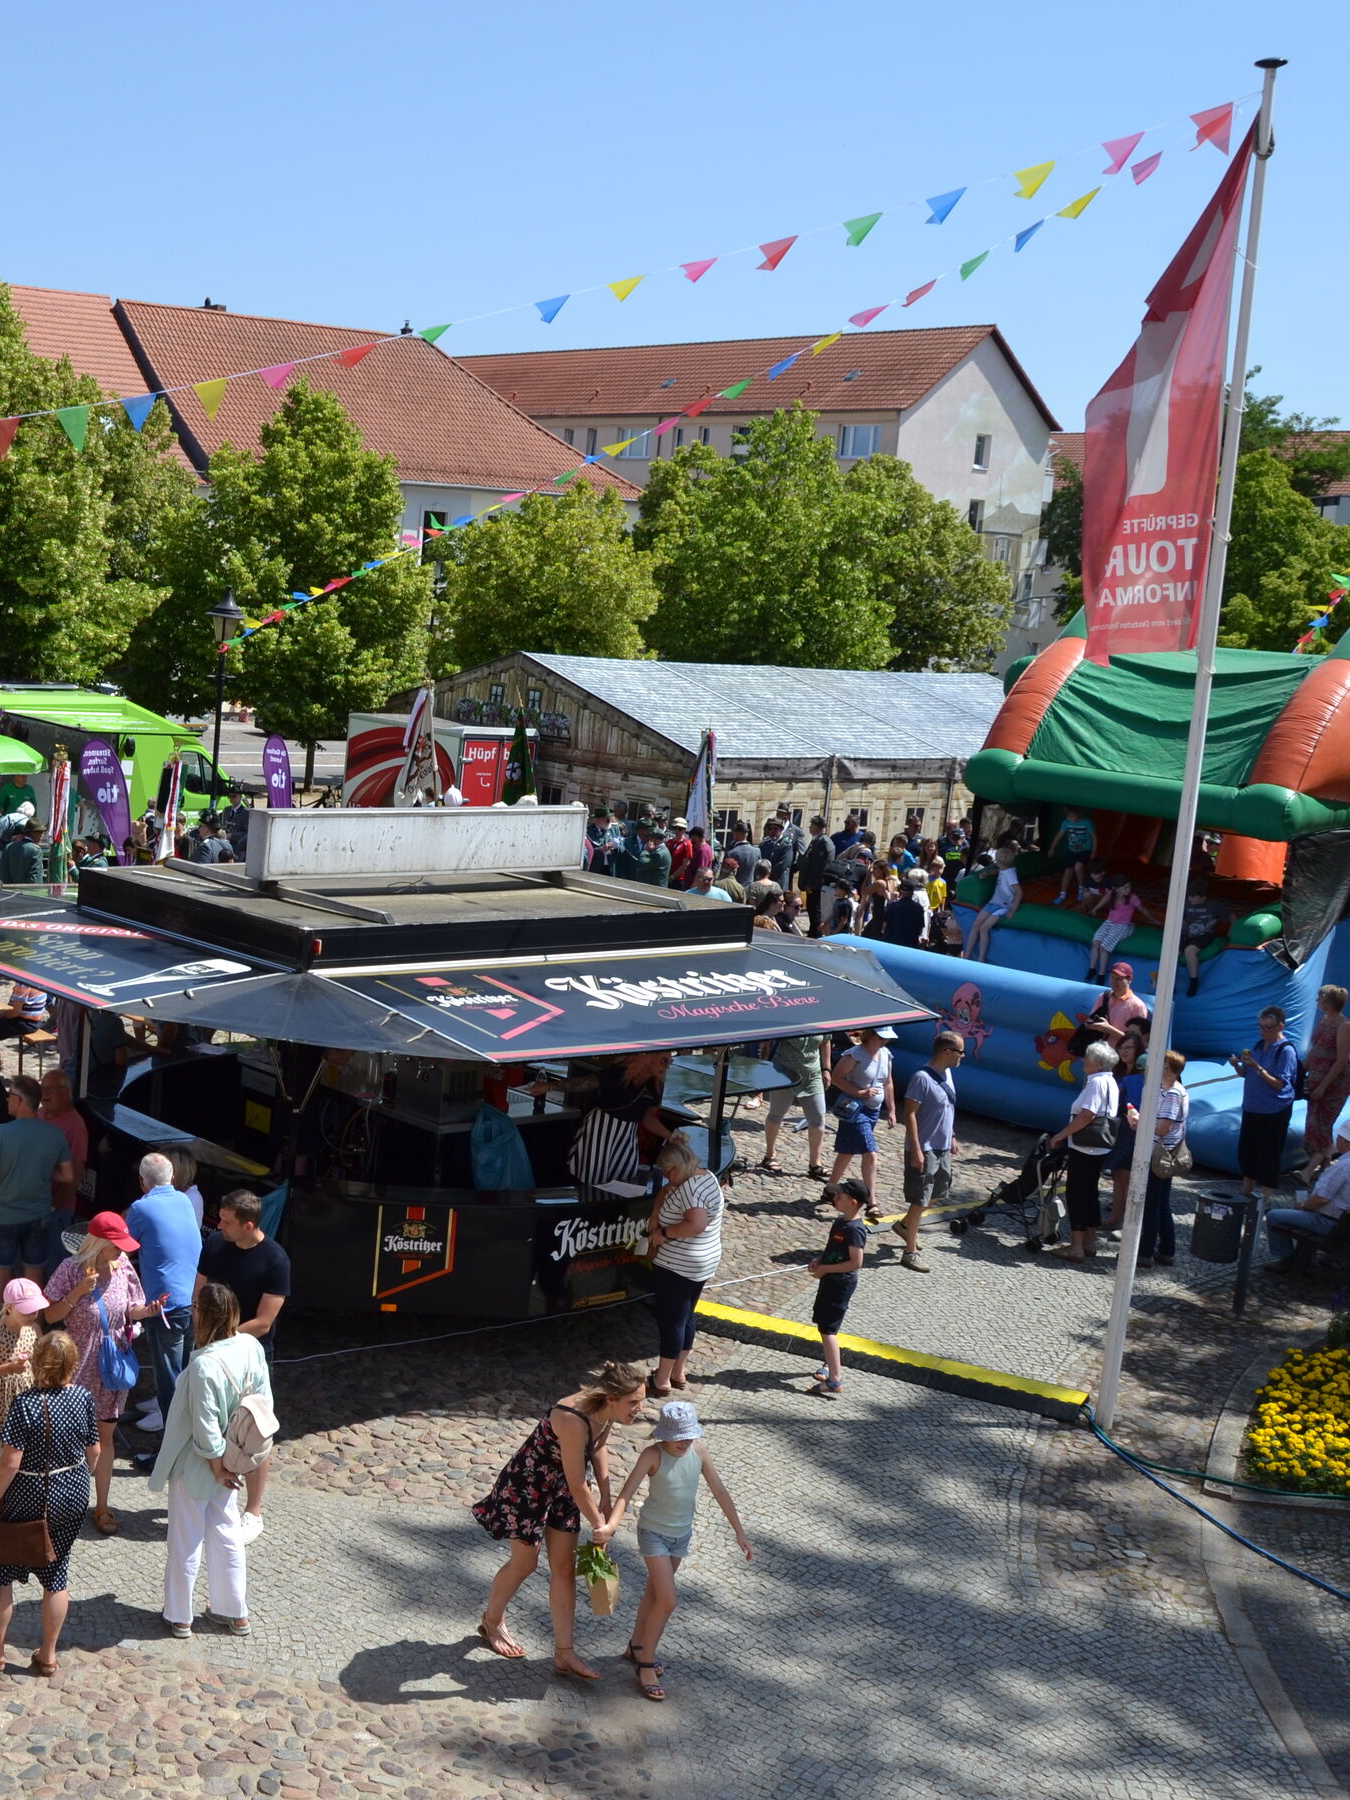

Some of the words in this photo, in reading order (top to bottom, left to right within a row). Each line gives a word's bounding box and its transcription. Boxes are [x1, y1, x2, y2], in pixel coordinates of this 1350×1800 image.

[469, 747, 497, 763] Hüpf
[1, 920, 39, 929] DAS
[45, 923, 144, 937] ORIGINAL
[24, 934, 104, 961] Schon
[545, 969, 811, 1010] Köstritzer
[657, 1001, 760, 1021] Magische
[757, 995, 820, 1009] Biere
[383, 1235, 443, 1254] Köstritzer
